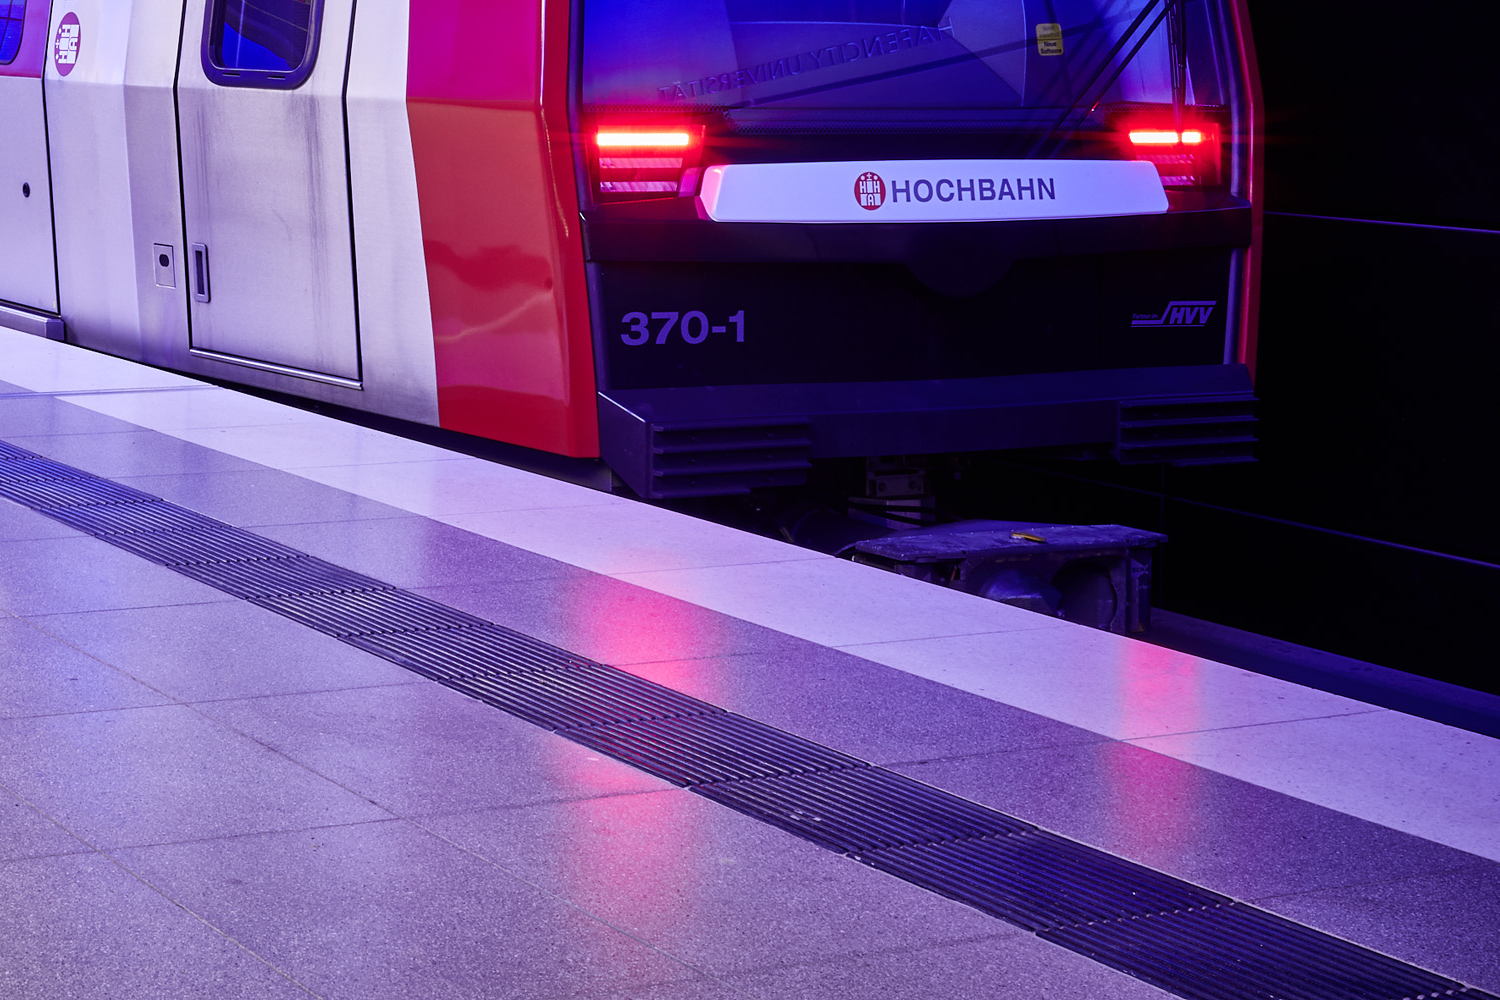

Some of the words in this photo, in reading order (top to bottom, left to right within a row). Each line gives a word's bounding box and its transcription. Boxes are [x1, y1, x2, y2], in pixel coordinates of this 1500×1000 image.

[891, 178, 1055, 203] HOCHBAHN
[620, 309, 746, 346] 370-1
[1169, 306, 1214, 324] HVV
